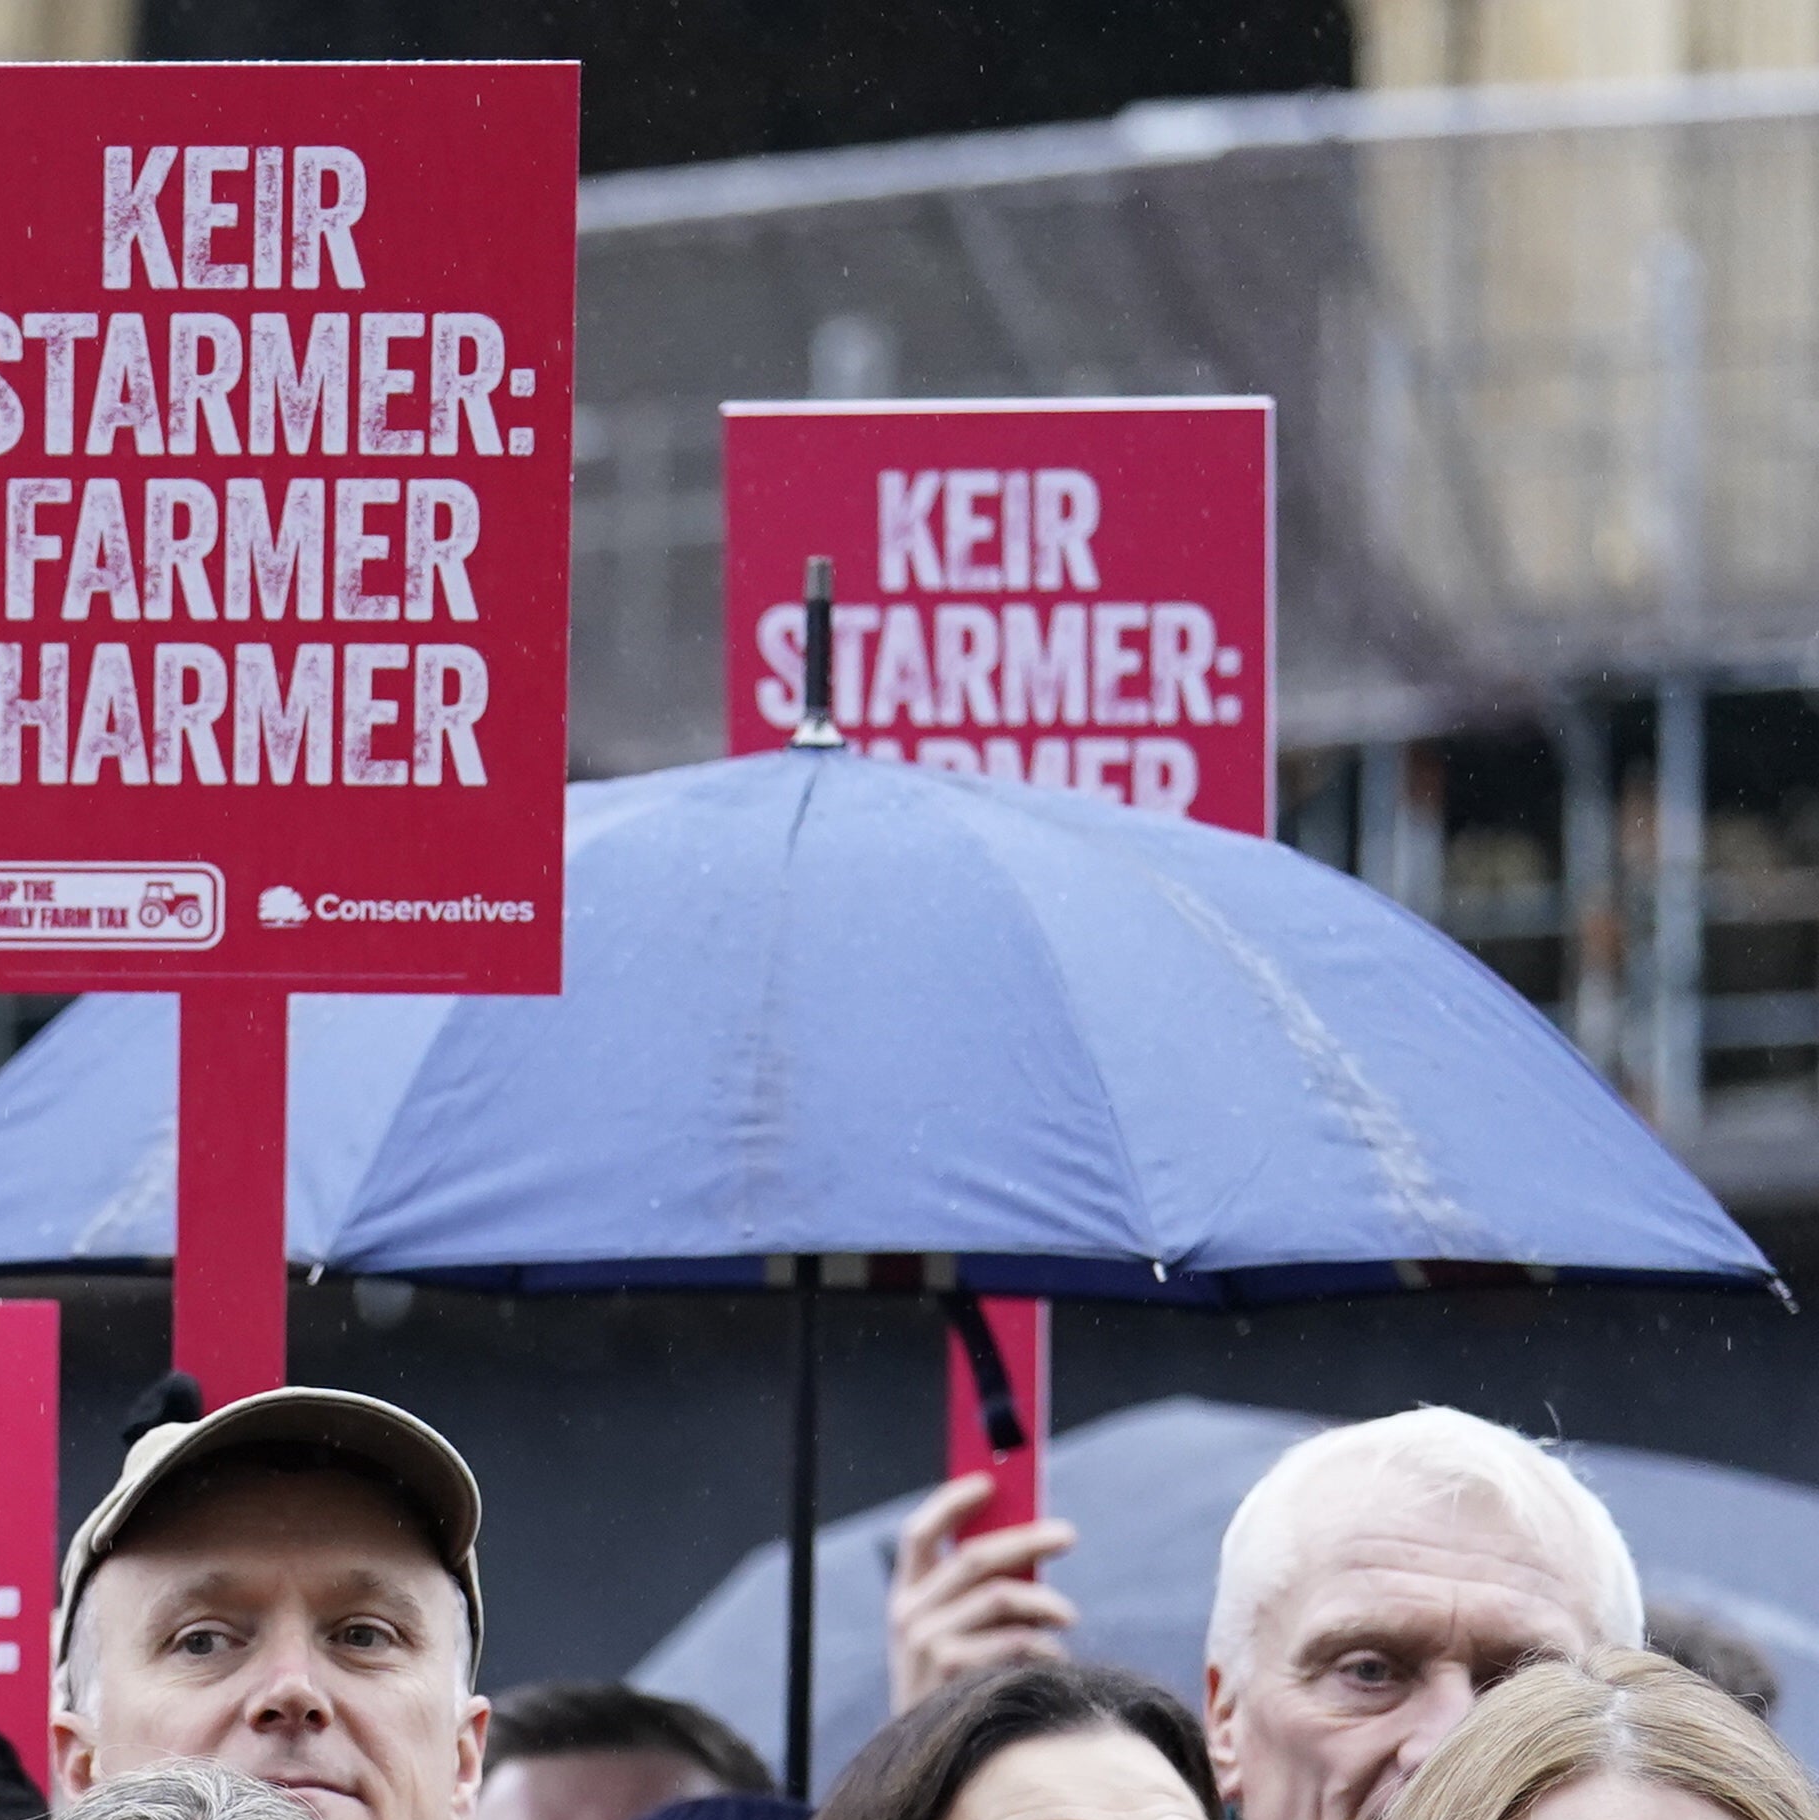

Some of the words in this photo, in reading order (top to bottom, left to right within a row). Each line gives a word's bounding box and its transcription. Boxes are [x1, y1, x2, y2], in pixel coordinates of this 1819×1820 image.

[102, 145, 367, 291] KEIR
[4, 477, 481, 623] FARMER
[876, 466, 1101, 593] KEIR
[755, 601, 1243, 730] STARMER:
[23, 880, 54, 901] THE
[41, 907, 92, 928] FARM
[98, 907, 129, 929] TAX
[314, 893, 536, 922] Conservatives
